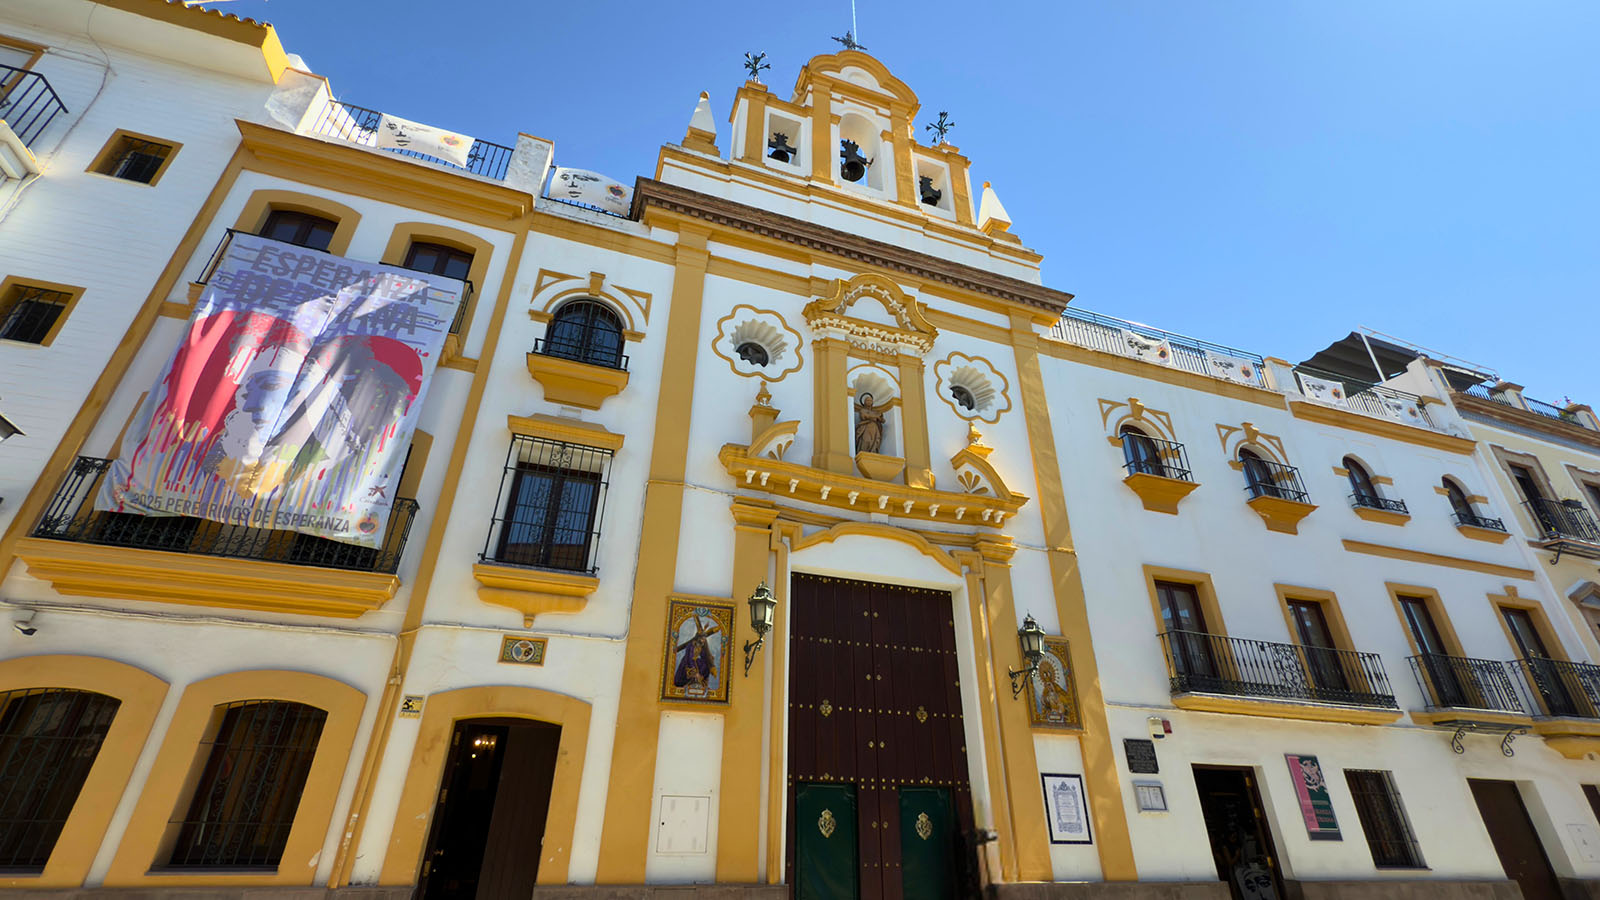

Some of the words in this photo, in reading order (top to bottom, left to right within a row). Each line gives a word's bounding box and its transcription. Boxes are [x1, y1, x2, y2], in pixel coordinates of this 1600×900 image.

[251, 245, 429, 305] ESPERANZA
[130, 493, 163, 509] 2025
[165, 497, 250, 521] PEREGRINOS
[252, 508, 270, 524] DE
[275, 510, 350, 533] ESPERANZA
